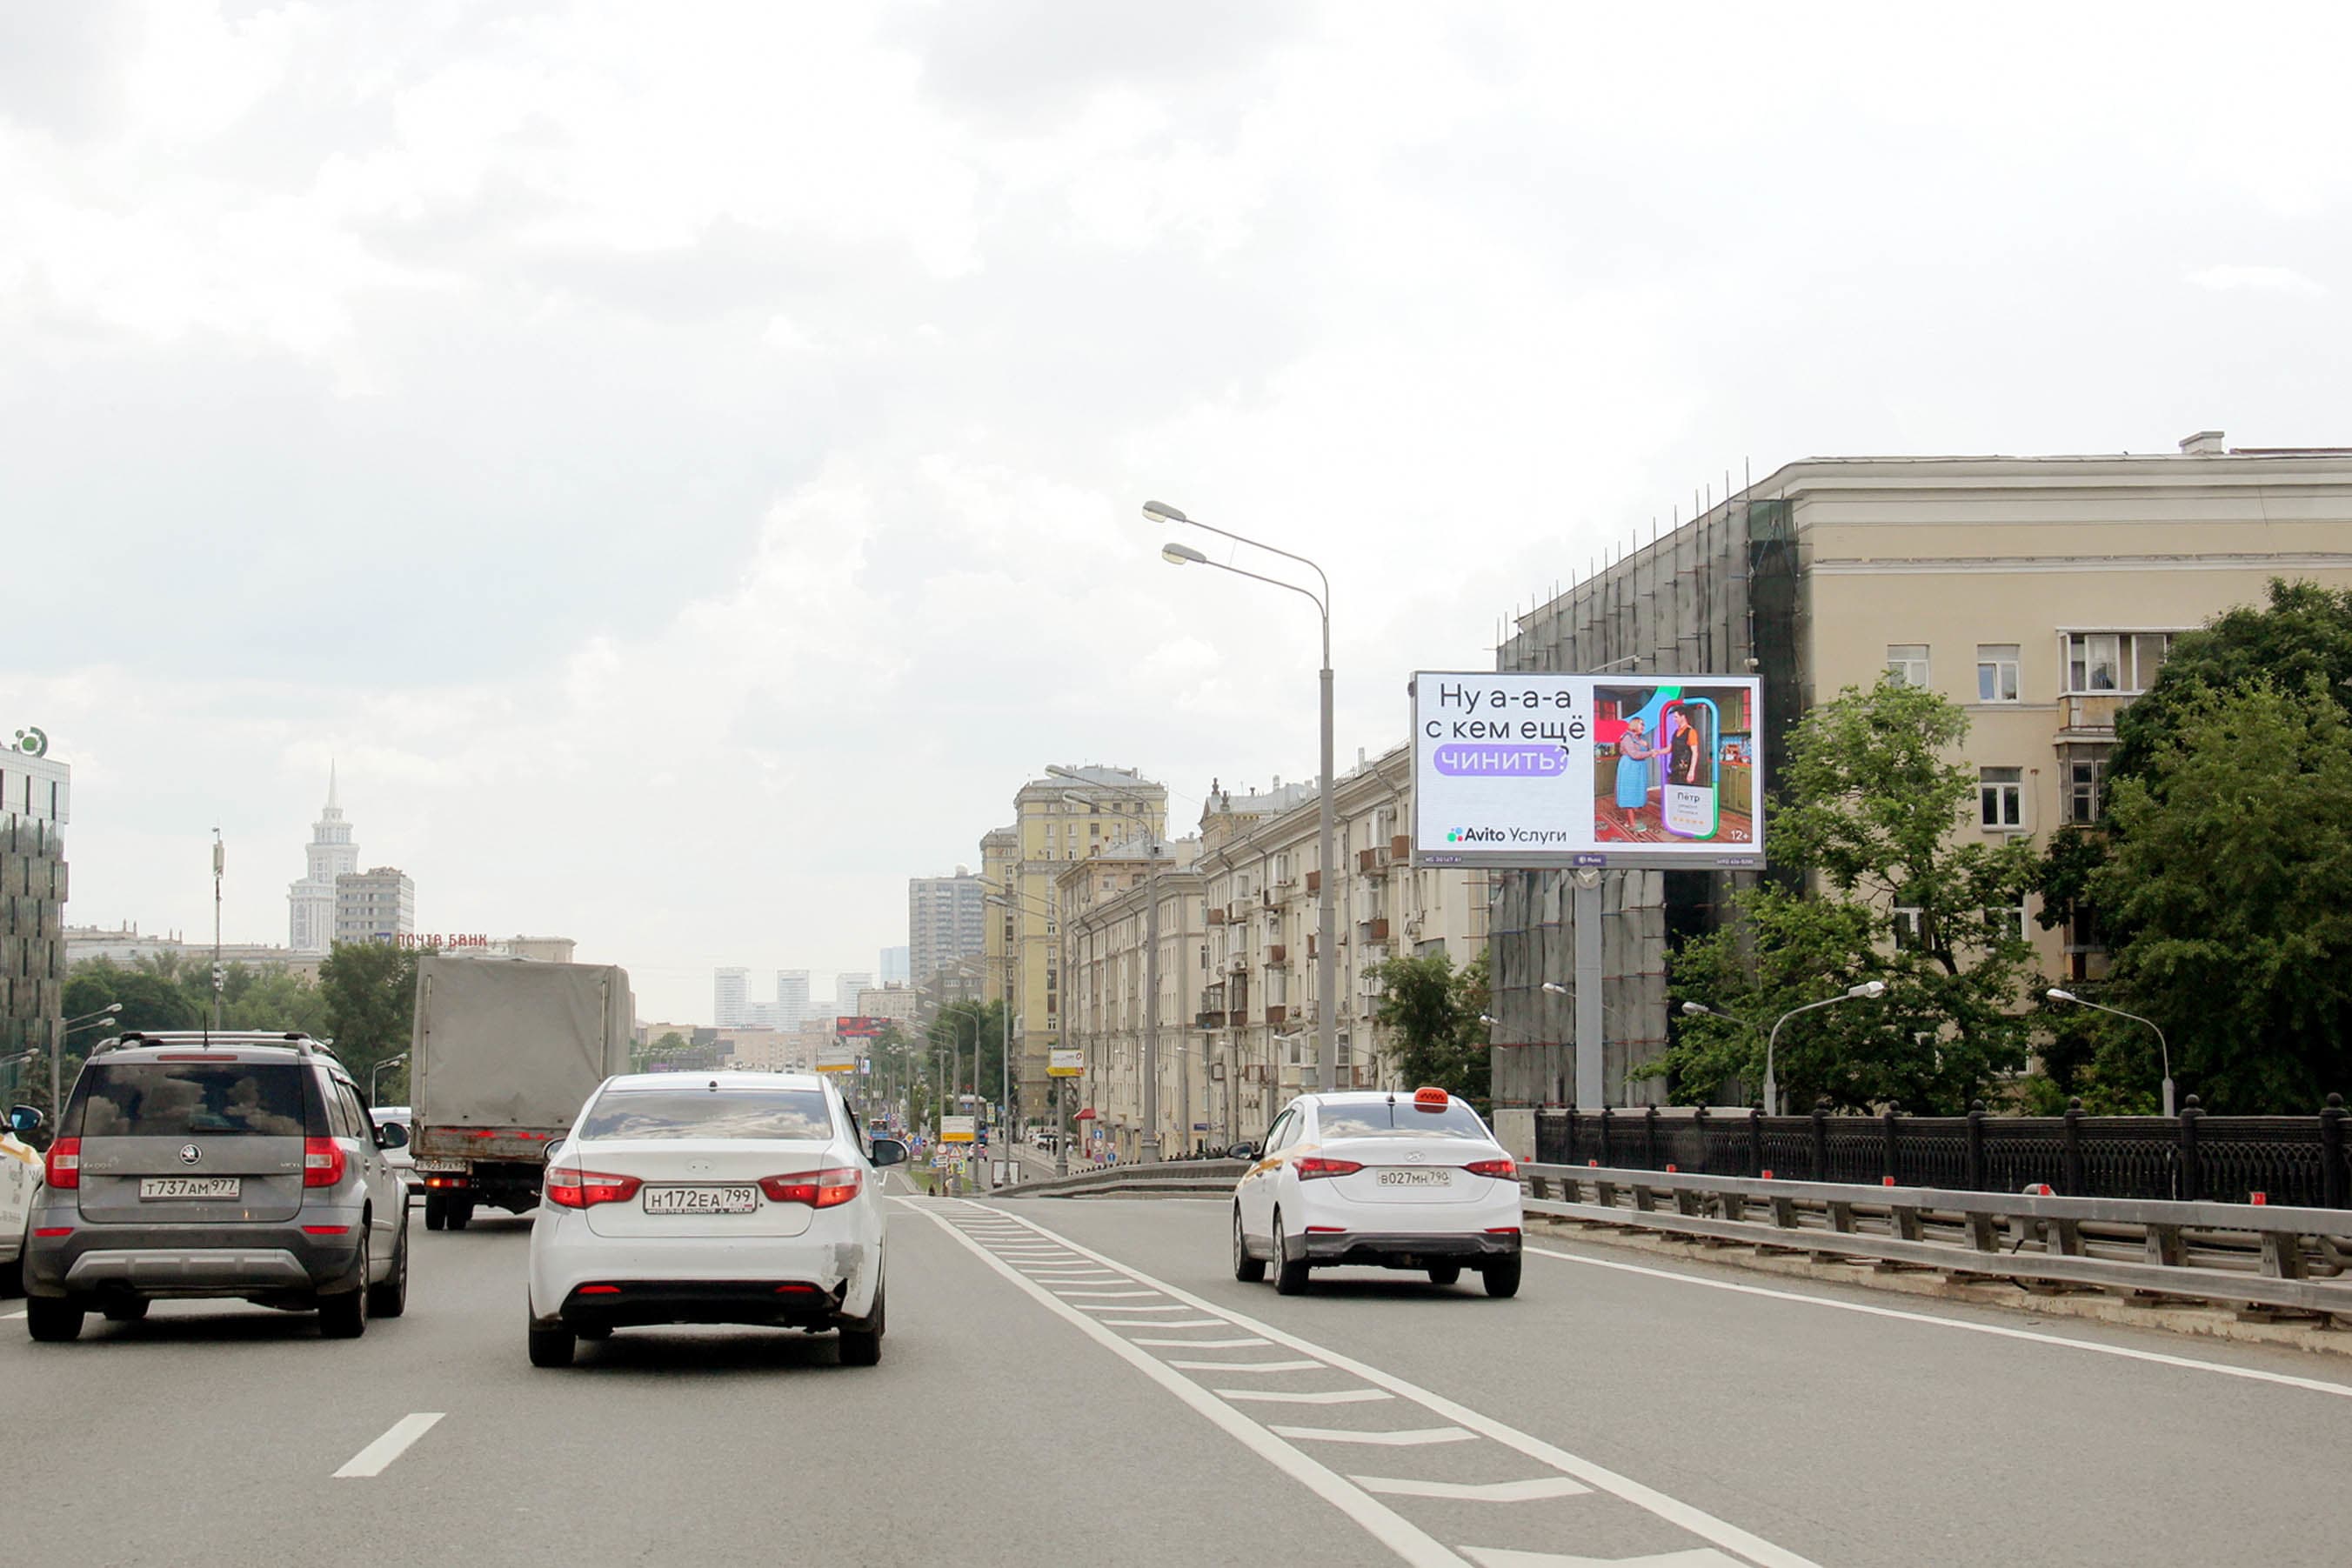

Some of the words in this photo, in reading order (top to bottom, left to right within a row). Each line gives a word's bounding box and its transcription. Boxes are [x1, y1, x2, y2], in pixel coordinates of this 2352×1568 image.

[1440, 683, 1480, 714] Ну
[1490, 690, 1571, 708] а-а-а
[1426, 720, 1441, 737] с
[1453, 721, 1509, 738] кем
[1520, 715, 1586, 743] ещё
[1465, 827, 1506, 842] Avito
[1509, 827, 1567, 844] Услуги
[1730, 830, 1749, 841] 12+
[397, 933, 443, 947] ПОЧТА
[448, 933, 487, 947] БАНК
